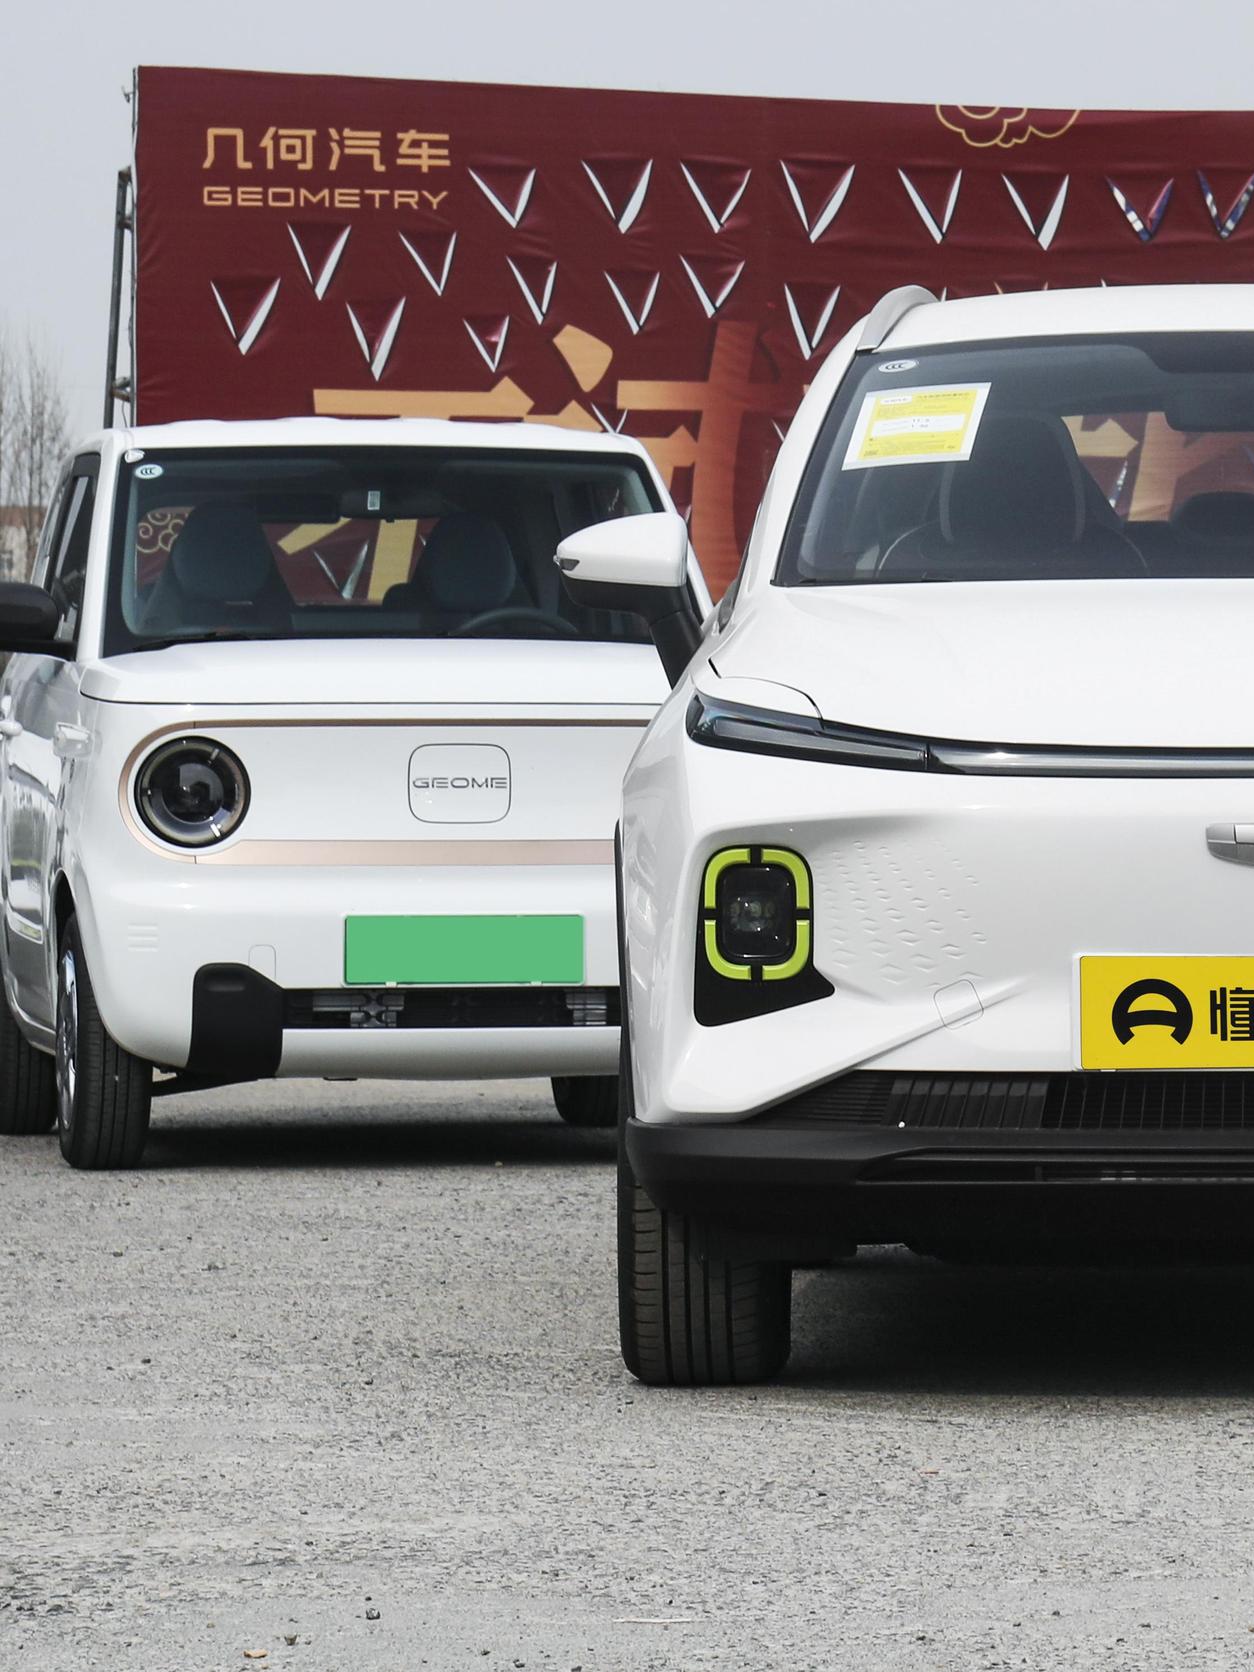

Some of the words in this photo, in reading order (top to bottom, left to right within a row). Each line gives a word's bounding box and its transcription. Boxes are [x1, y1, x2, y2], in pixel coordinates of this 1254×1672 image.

[202, 126, 451, 173] 几何汽车
[203, 186, 449, 210] GEOMETRY
[412, 777, 508, 789] GEOME
